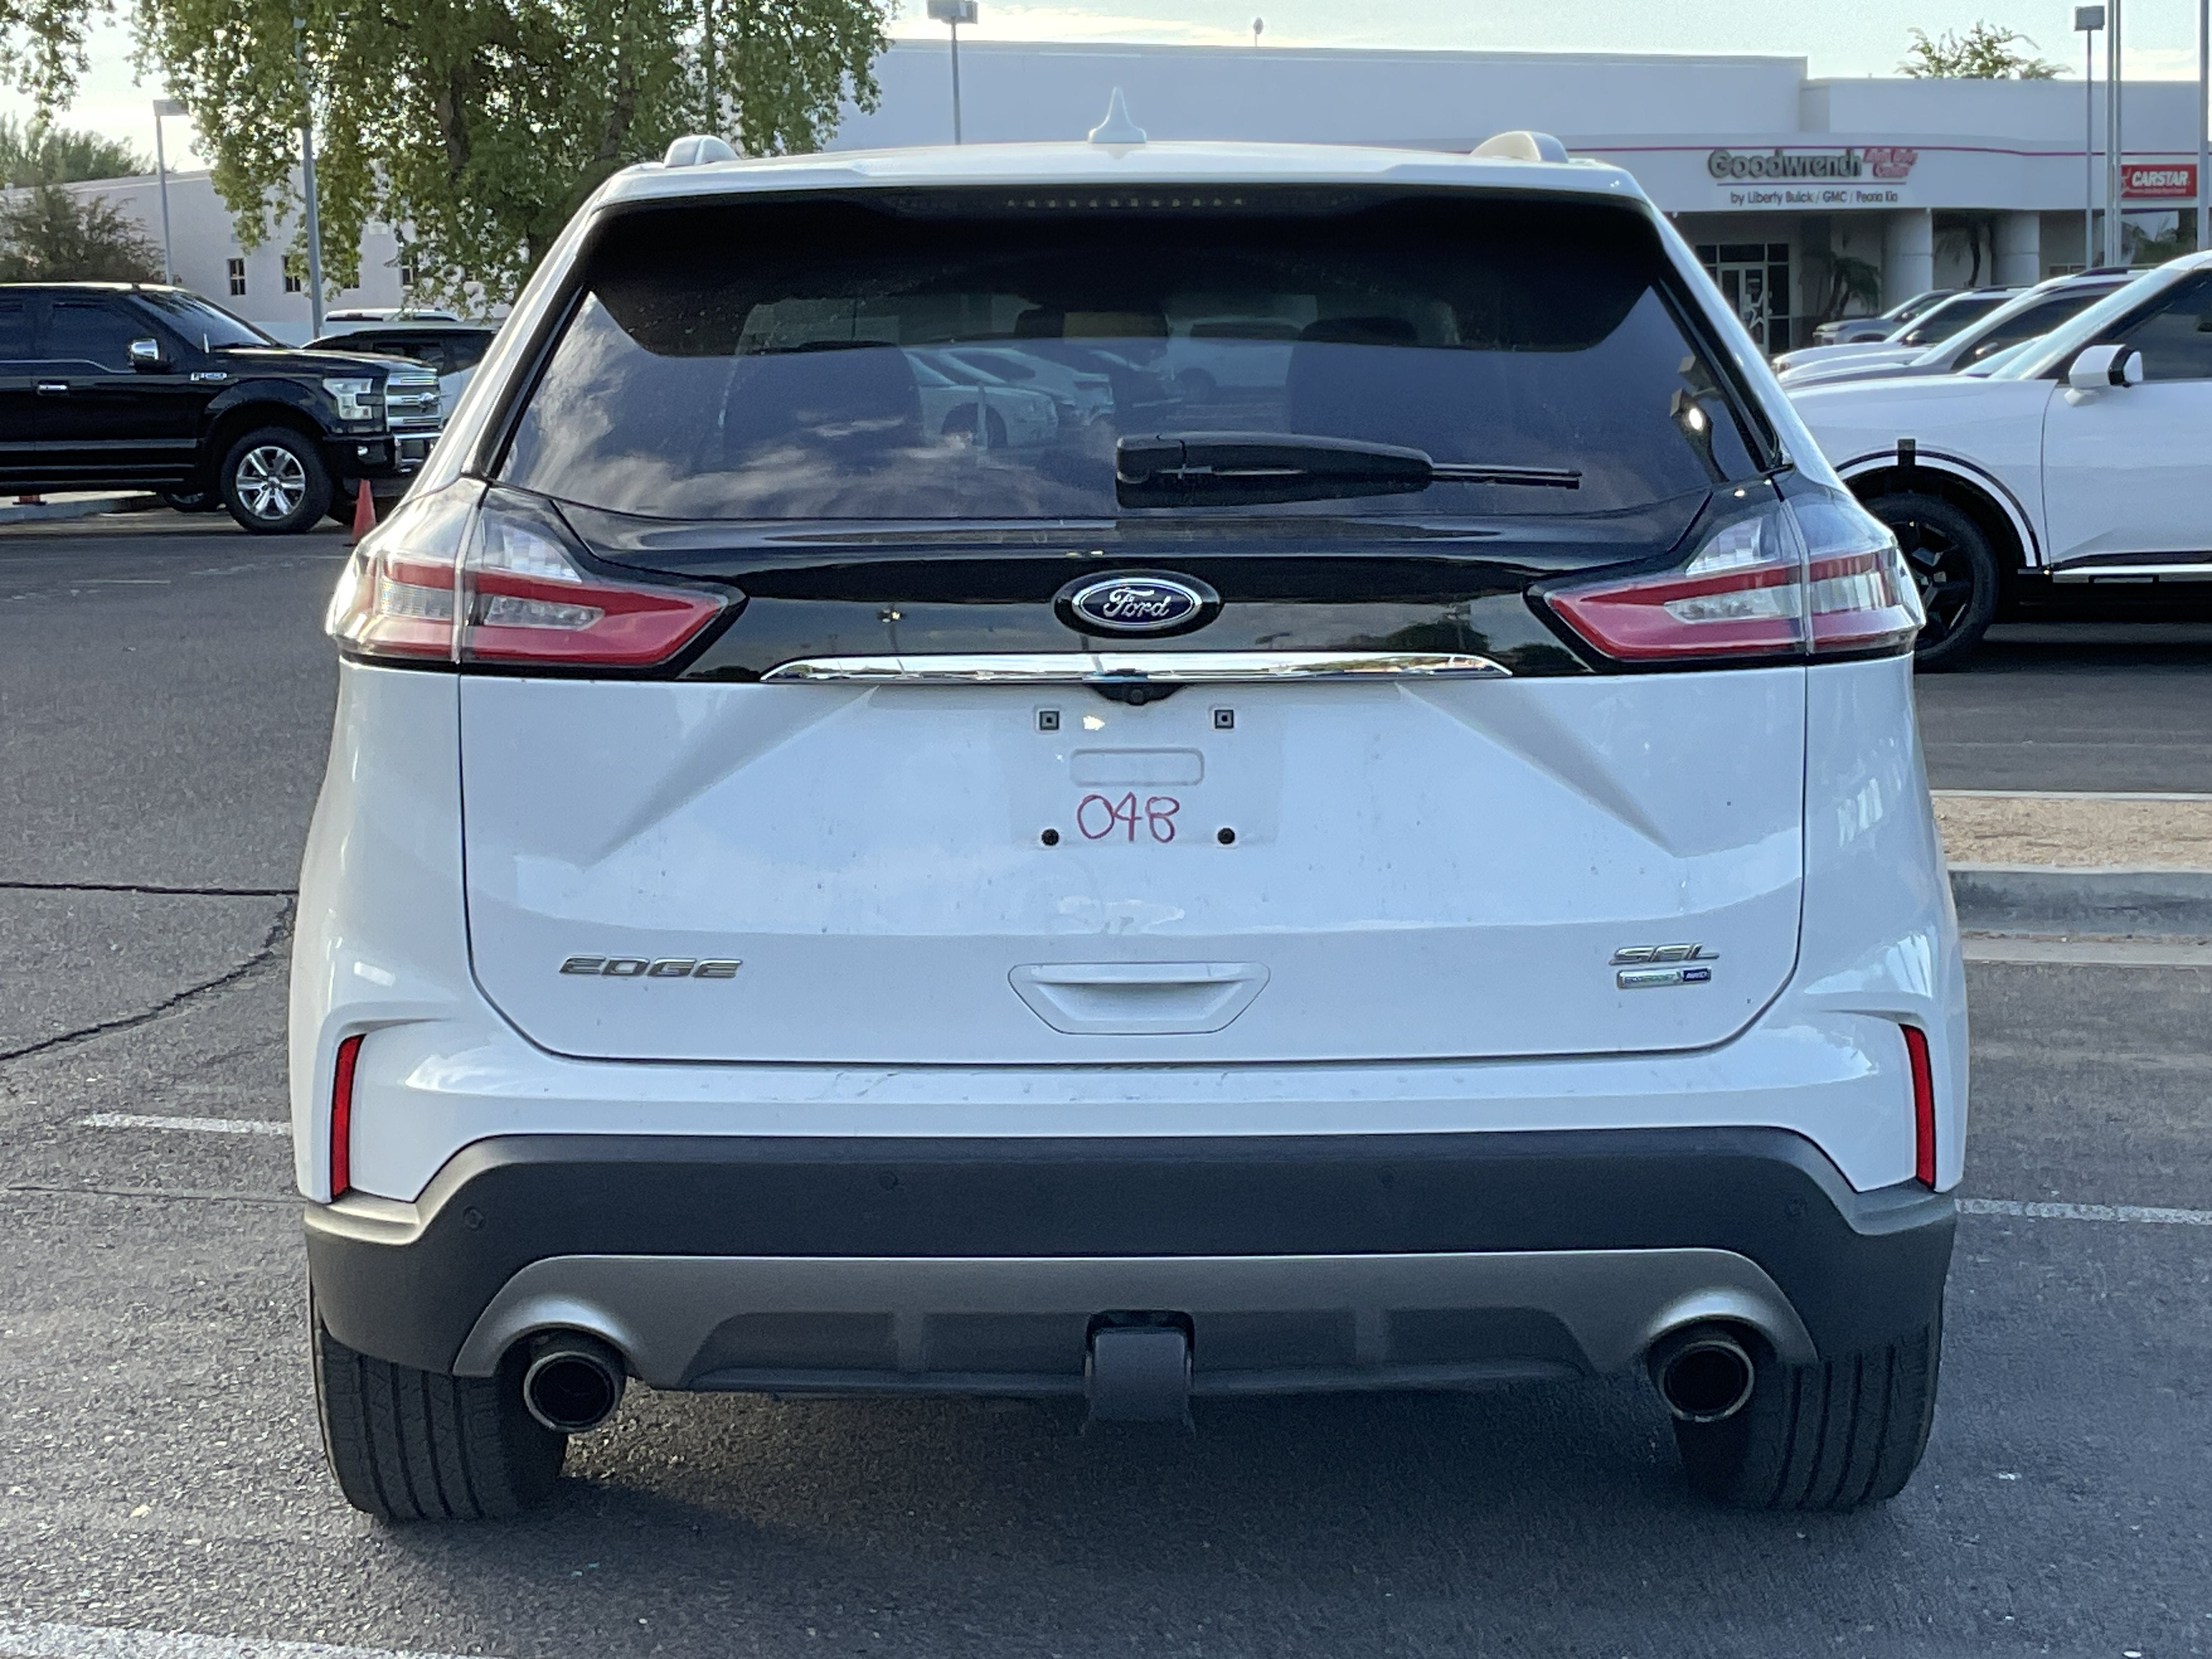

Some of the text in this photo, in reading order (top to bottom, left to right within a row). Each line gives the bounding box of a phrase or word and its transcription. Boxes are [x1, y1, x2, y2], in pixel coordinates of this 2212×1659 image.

[1708, 148, 1862, 178] Goodwrench
[2131, 171, 2188, 187] CARSTAR
[1730, 191, 1745, 206] by
[1748, 191, 1782, 206] Liberty
[1786, 191, 1813, 204] Buick
[1822, 191, 1848, 203] GMC
[1103, 587, 1171, 617] Ford
[1609, 942, 1720, 966] SEL
[559, 955, 743, 979] EDGE
